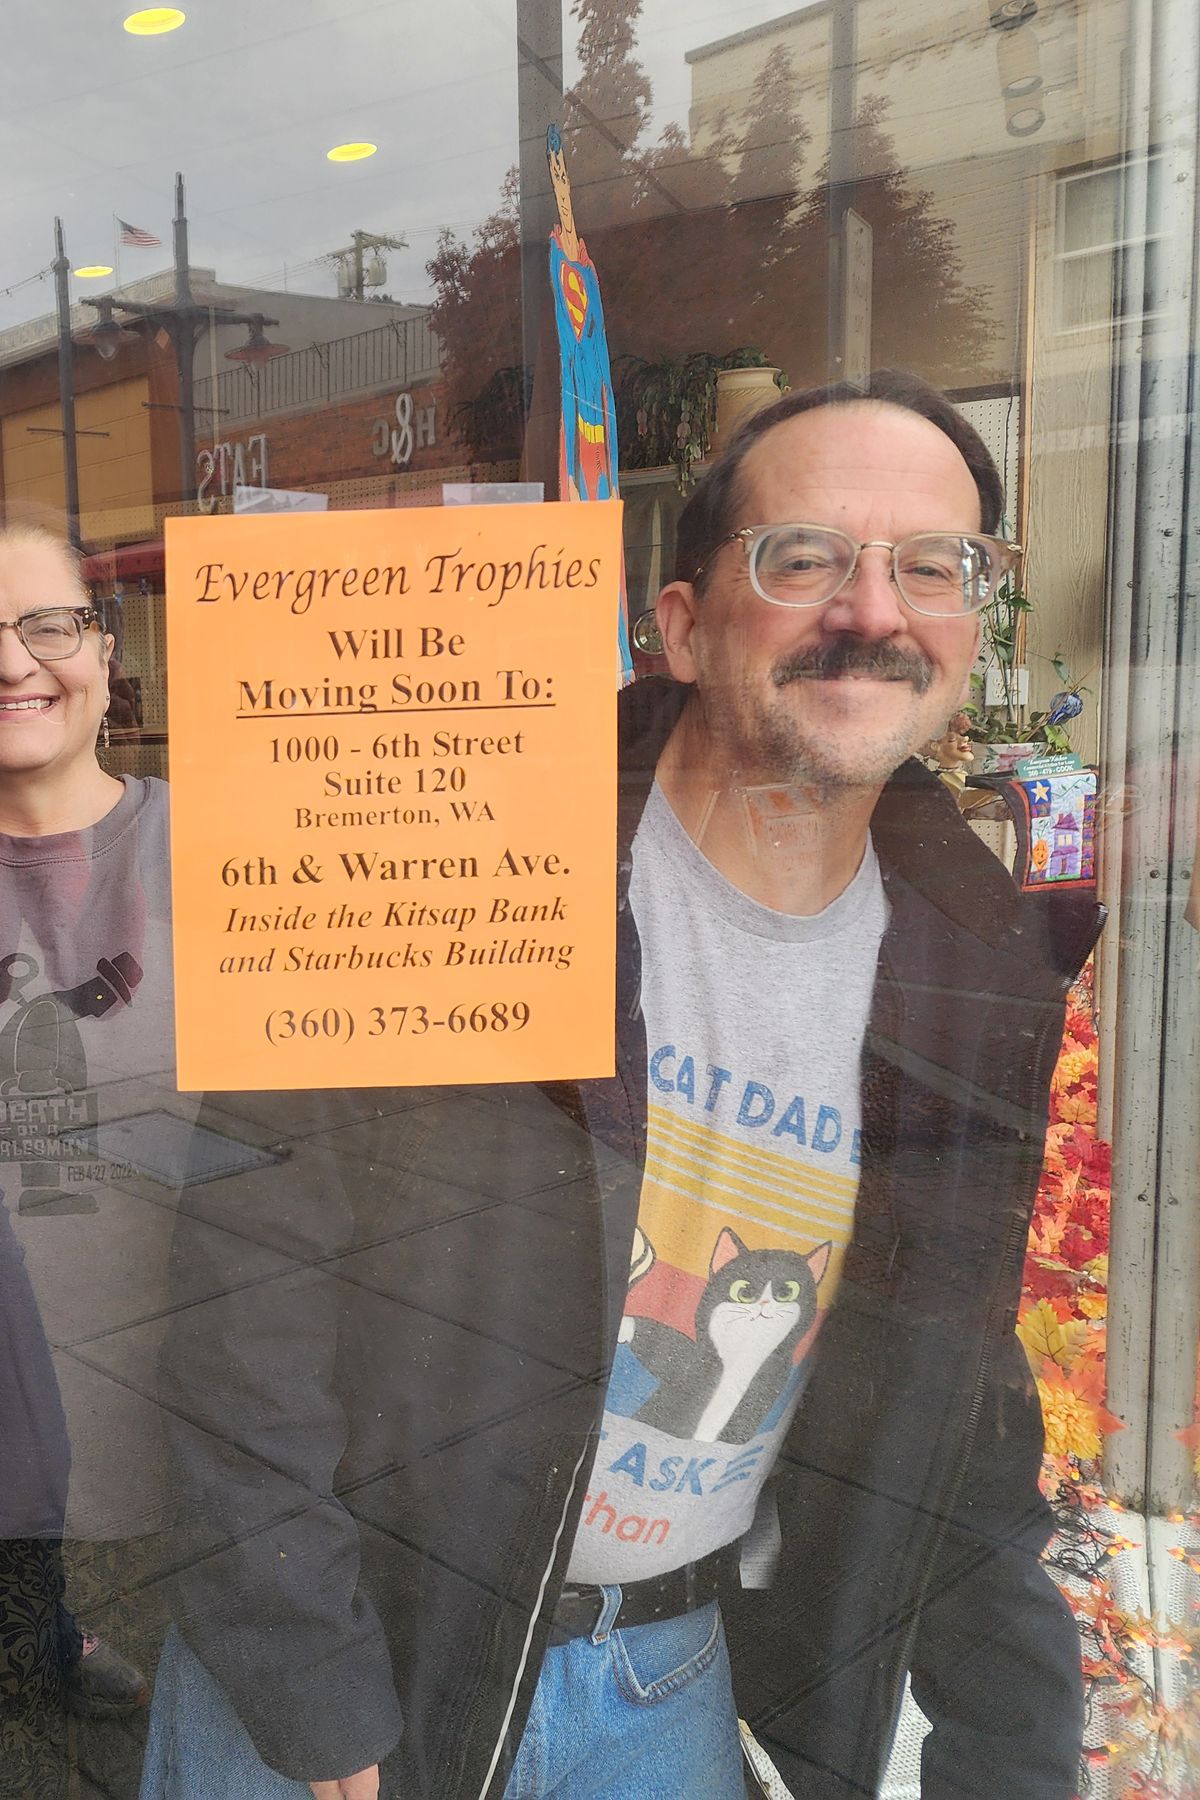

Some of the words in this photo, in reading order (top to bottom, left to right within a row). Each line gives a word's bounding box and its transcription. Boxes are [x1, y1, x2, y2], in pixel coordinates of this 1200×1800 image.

[195, 562, 410, 615] Evergreen
[425, 544, 601, 608] Trophies
[327, 628, 403, 660] Will
[419, 627, 465, 657] Be
[237, 677, 378, 712] Moving
[391, 674, 481, 705] Soon
[497, 669, 554, 700] To:
[270, 736, 339, 763] 1000
[372, 732, 420, 759] 6th
[432, 730, 524, 757] Street
[324, 771, 402, 797] Suite
[416, 766, 466, 793] 120
[296, 807, 440, 829] Bremerton,
[450, 801, 496, 822] WA
[221, 856, 277, 887] 6th
[292, 854, 323, 884] &
[338, 851, 479, 882] Warren
[492, 848, 571, 877] Ave.
[223, 906, 317, 934] Inside
[327, 903, 373, 929] the
[383, 901, 477, 933] Kitsap
[488, 896, 568, 923] Bank
[219, 947, 276, 974] and
[283, 943, 433, 972] Starbucks
[444, 939, 575, 970] Building
[265, 1007, 355, 1046] (360)
[368, 1002, 530, 1036] 373-6689
[649, 1044, 733, 1113] CAT
[736, 1080, 843, 1154] DAD
[608, 1442, 717, 1496] ASK
[584, 1491, 671, 1546] han
